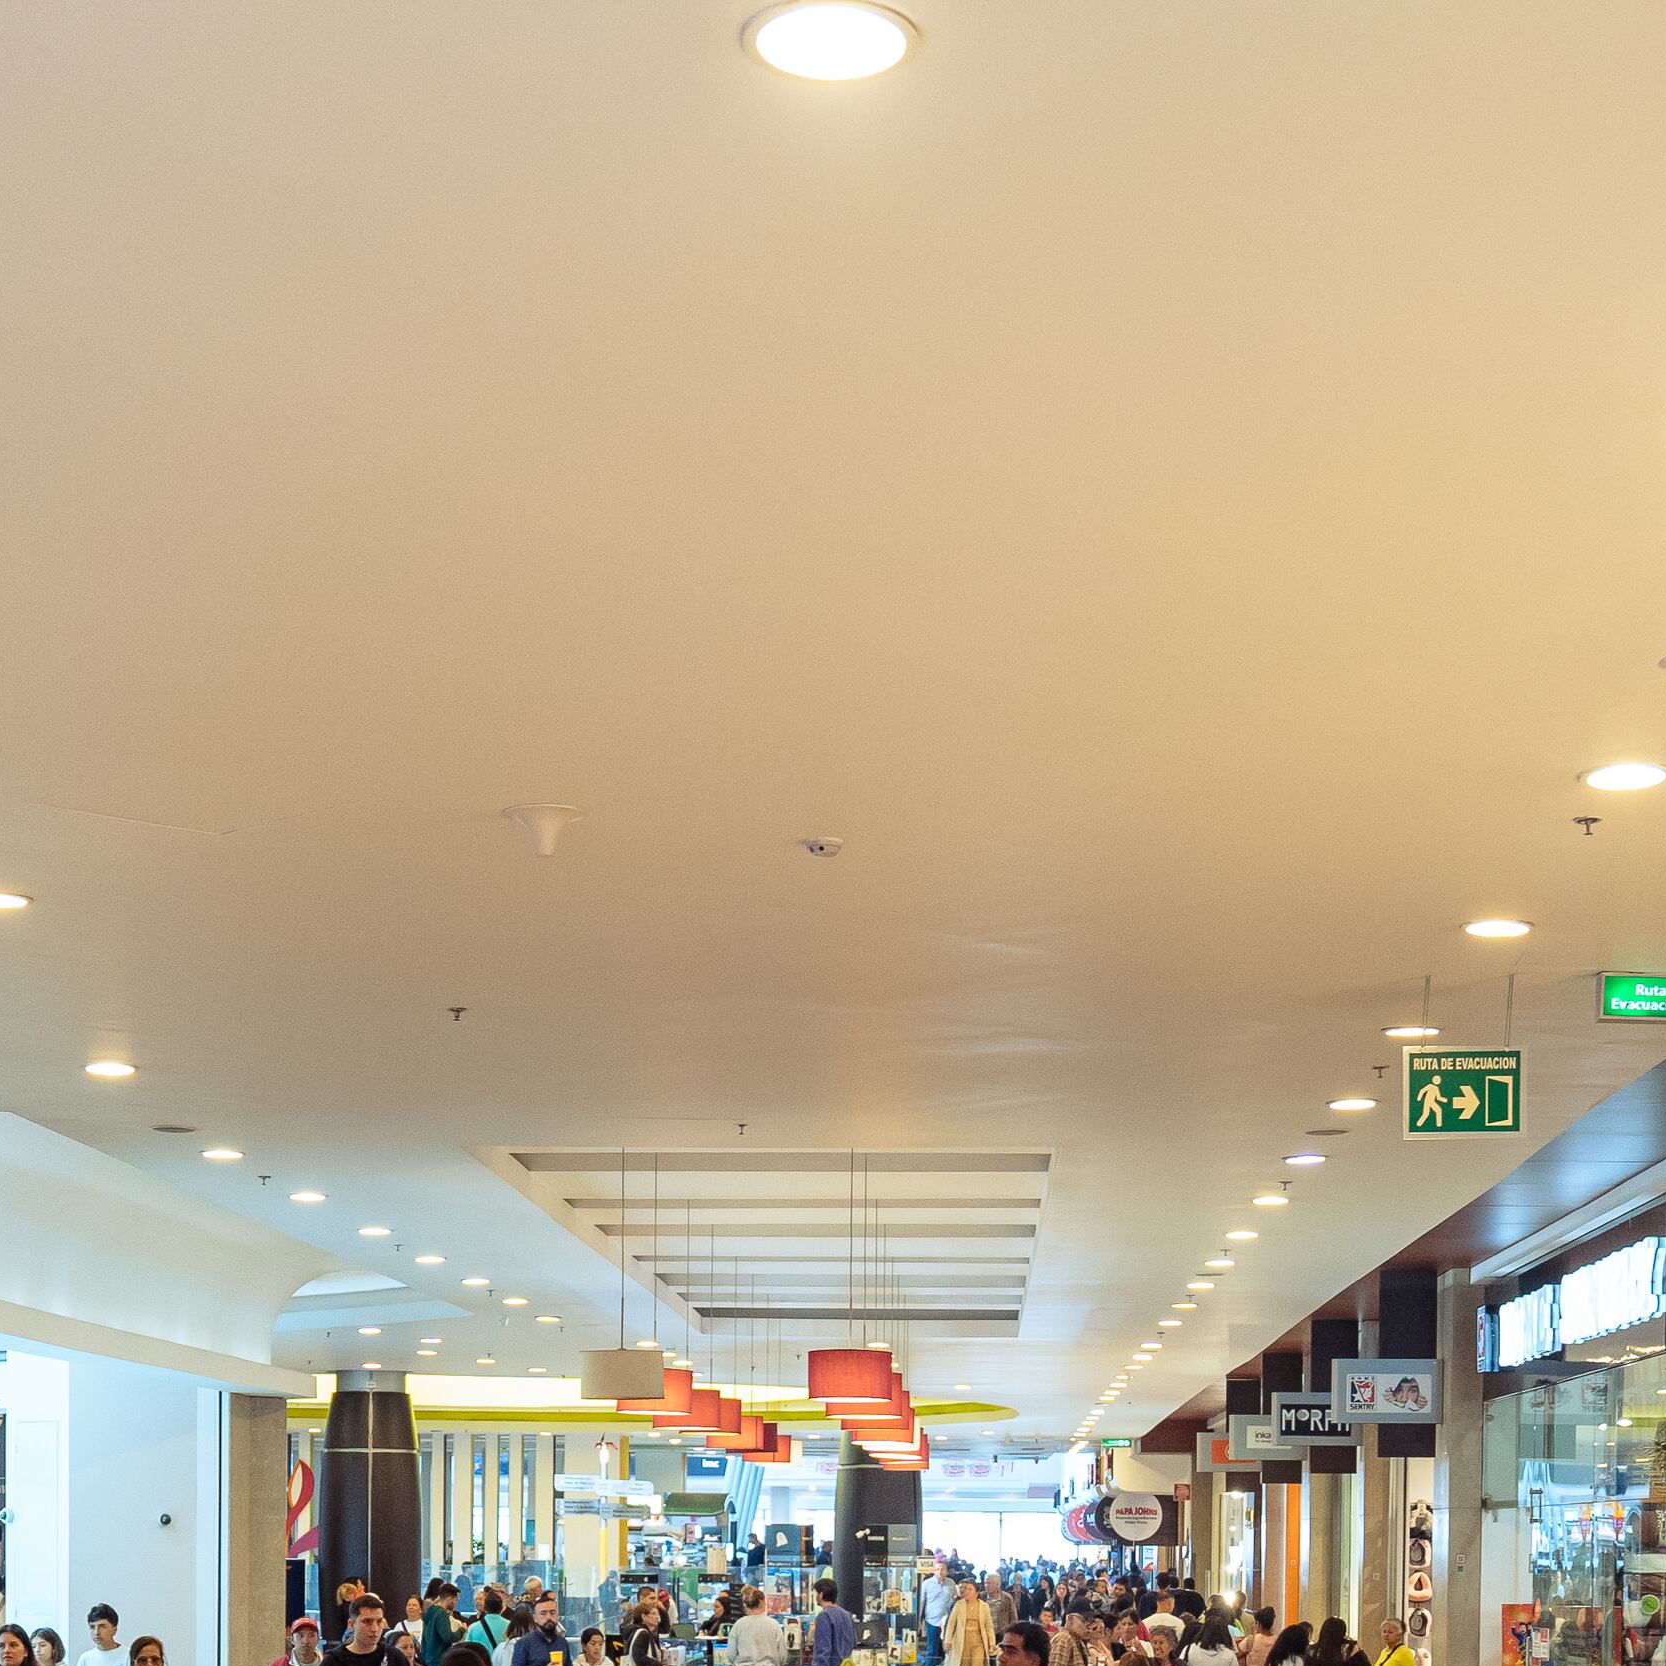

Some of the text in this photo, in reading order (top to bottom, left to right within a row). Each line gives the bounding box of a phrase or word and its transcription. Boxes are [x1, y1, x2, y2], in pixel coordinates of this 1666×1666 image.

[1636, 984, 1666, 997] Ruta
[1413, 1057, 1517, 1071] RUTA DE EVACUACION
[1115, 1507, 1158, 1516] PAPA JOHNS
